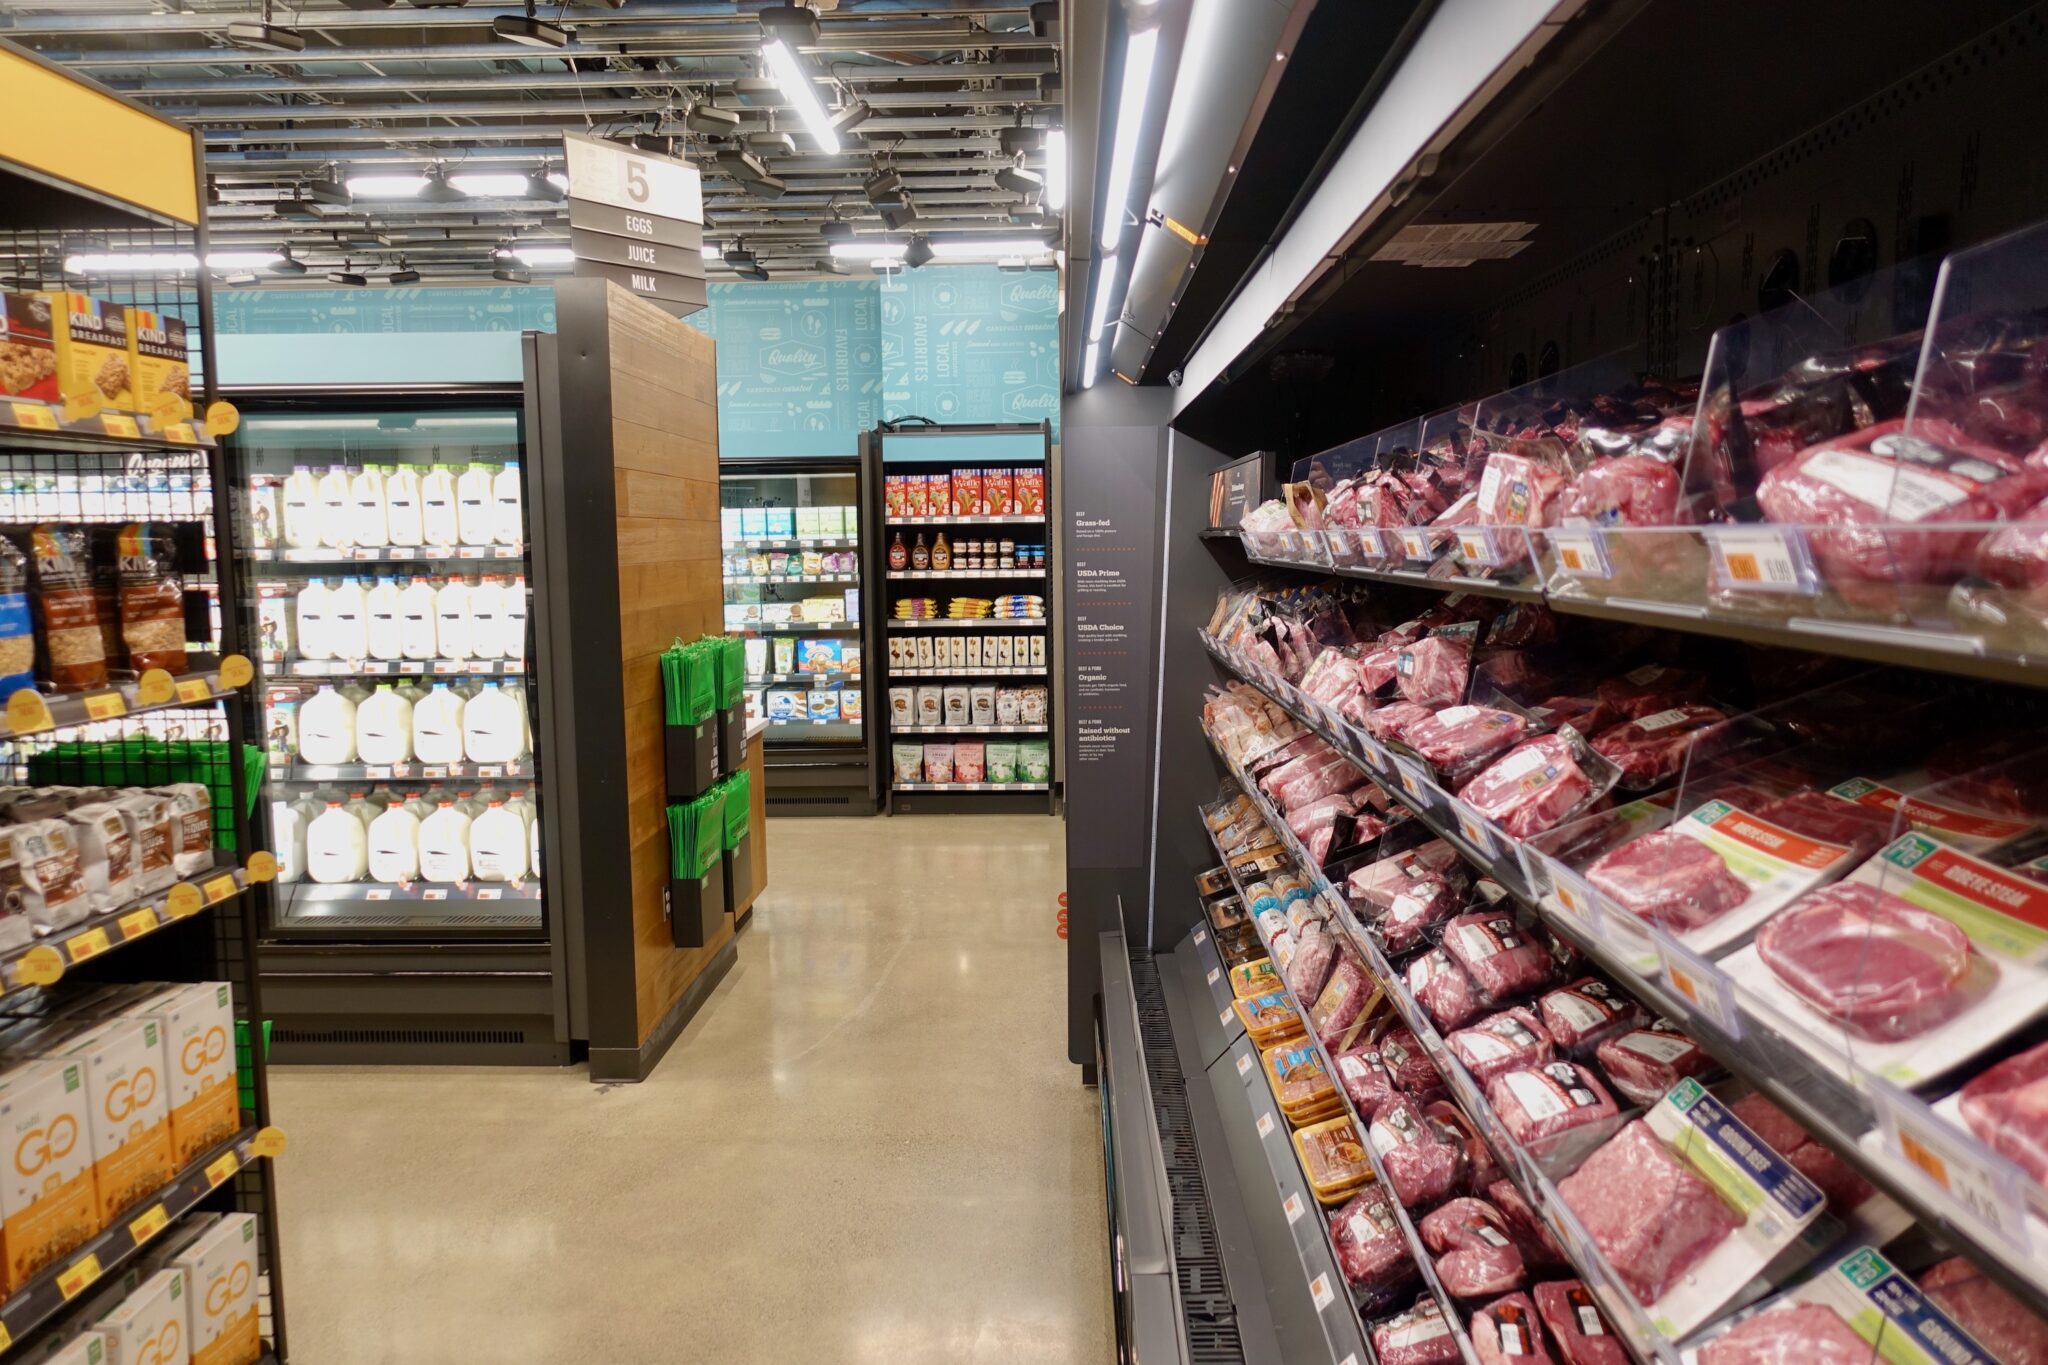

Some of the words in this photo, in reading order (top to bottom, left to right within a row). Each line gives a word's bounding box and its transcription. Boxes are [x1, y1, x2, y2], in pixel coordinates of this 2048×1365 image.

[626, 160, 650, 203] 5
[626, 215, 653, 235] EGGS
[628, 244, 656, 264] JUICE
[632, 274, 657, 292] MILK
[70, 311, 103, 330] KIND
[854, 297, 868, 331] LOCAL
[70, 329, 128, 348] BREAKFAST
[137, 328, 167, 344] KIND
[138, 343, 188, 360] BREAKFAST
[768, 348, 822, 368] Quality
[913, 315, 929, 382] FAVORITES
[834, 328, 849, 392] FAVORITES
[936, 341, 950, 378] LOCAL
[953, 479, 981, 488] Waffle
[984, 478, 1012, 488] Waffle
[1015, 478, 1043, 488] Waffle
[1078, 674, 1107, 682] Organic
[1078, 734, 1117, 742] antibiotics
[181, 1025, 227, 1076] GO
[104, 1066, 157, 1122] GO
[14, 1112, 78, 1176] GO
[204, 1259, 251, 1317] GO
